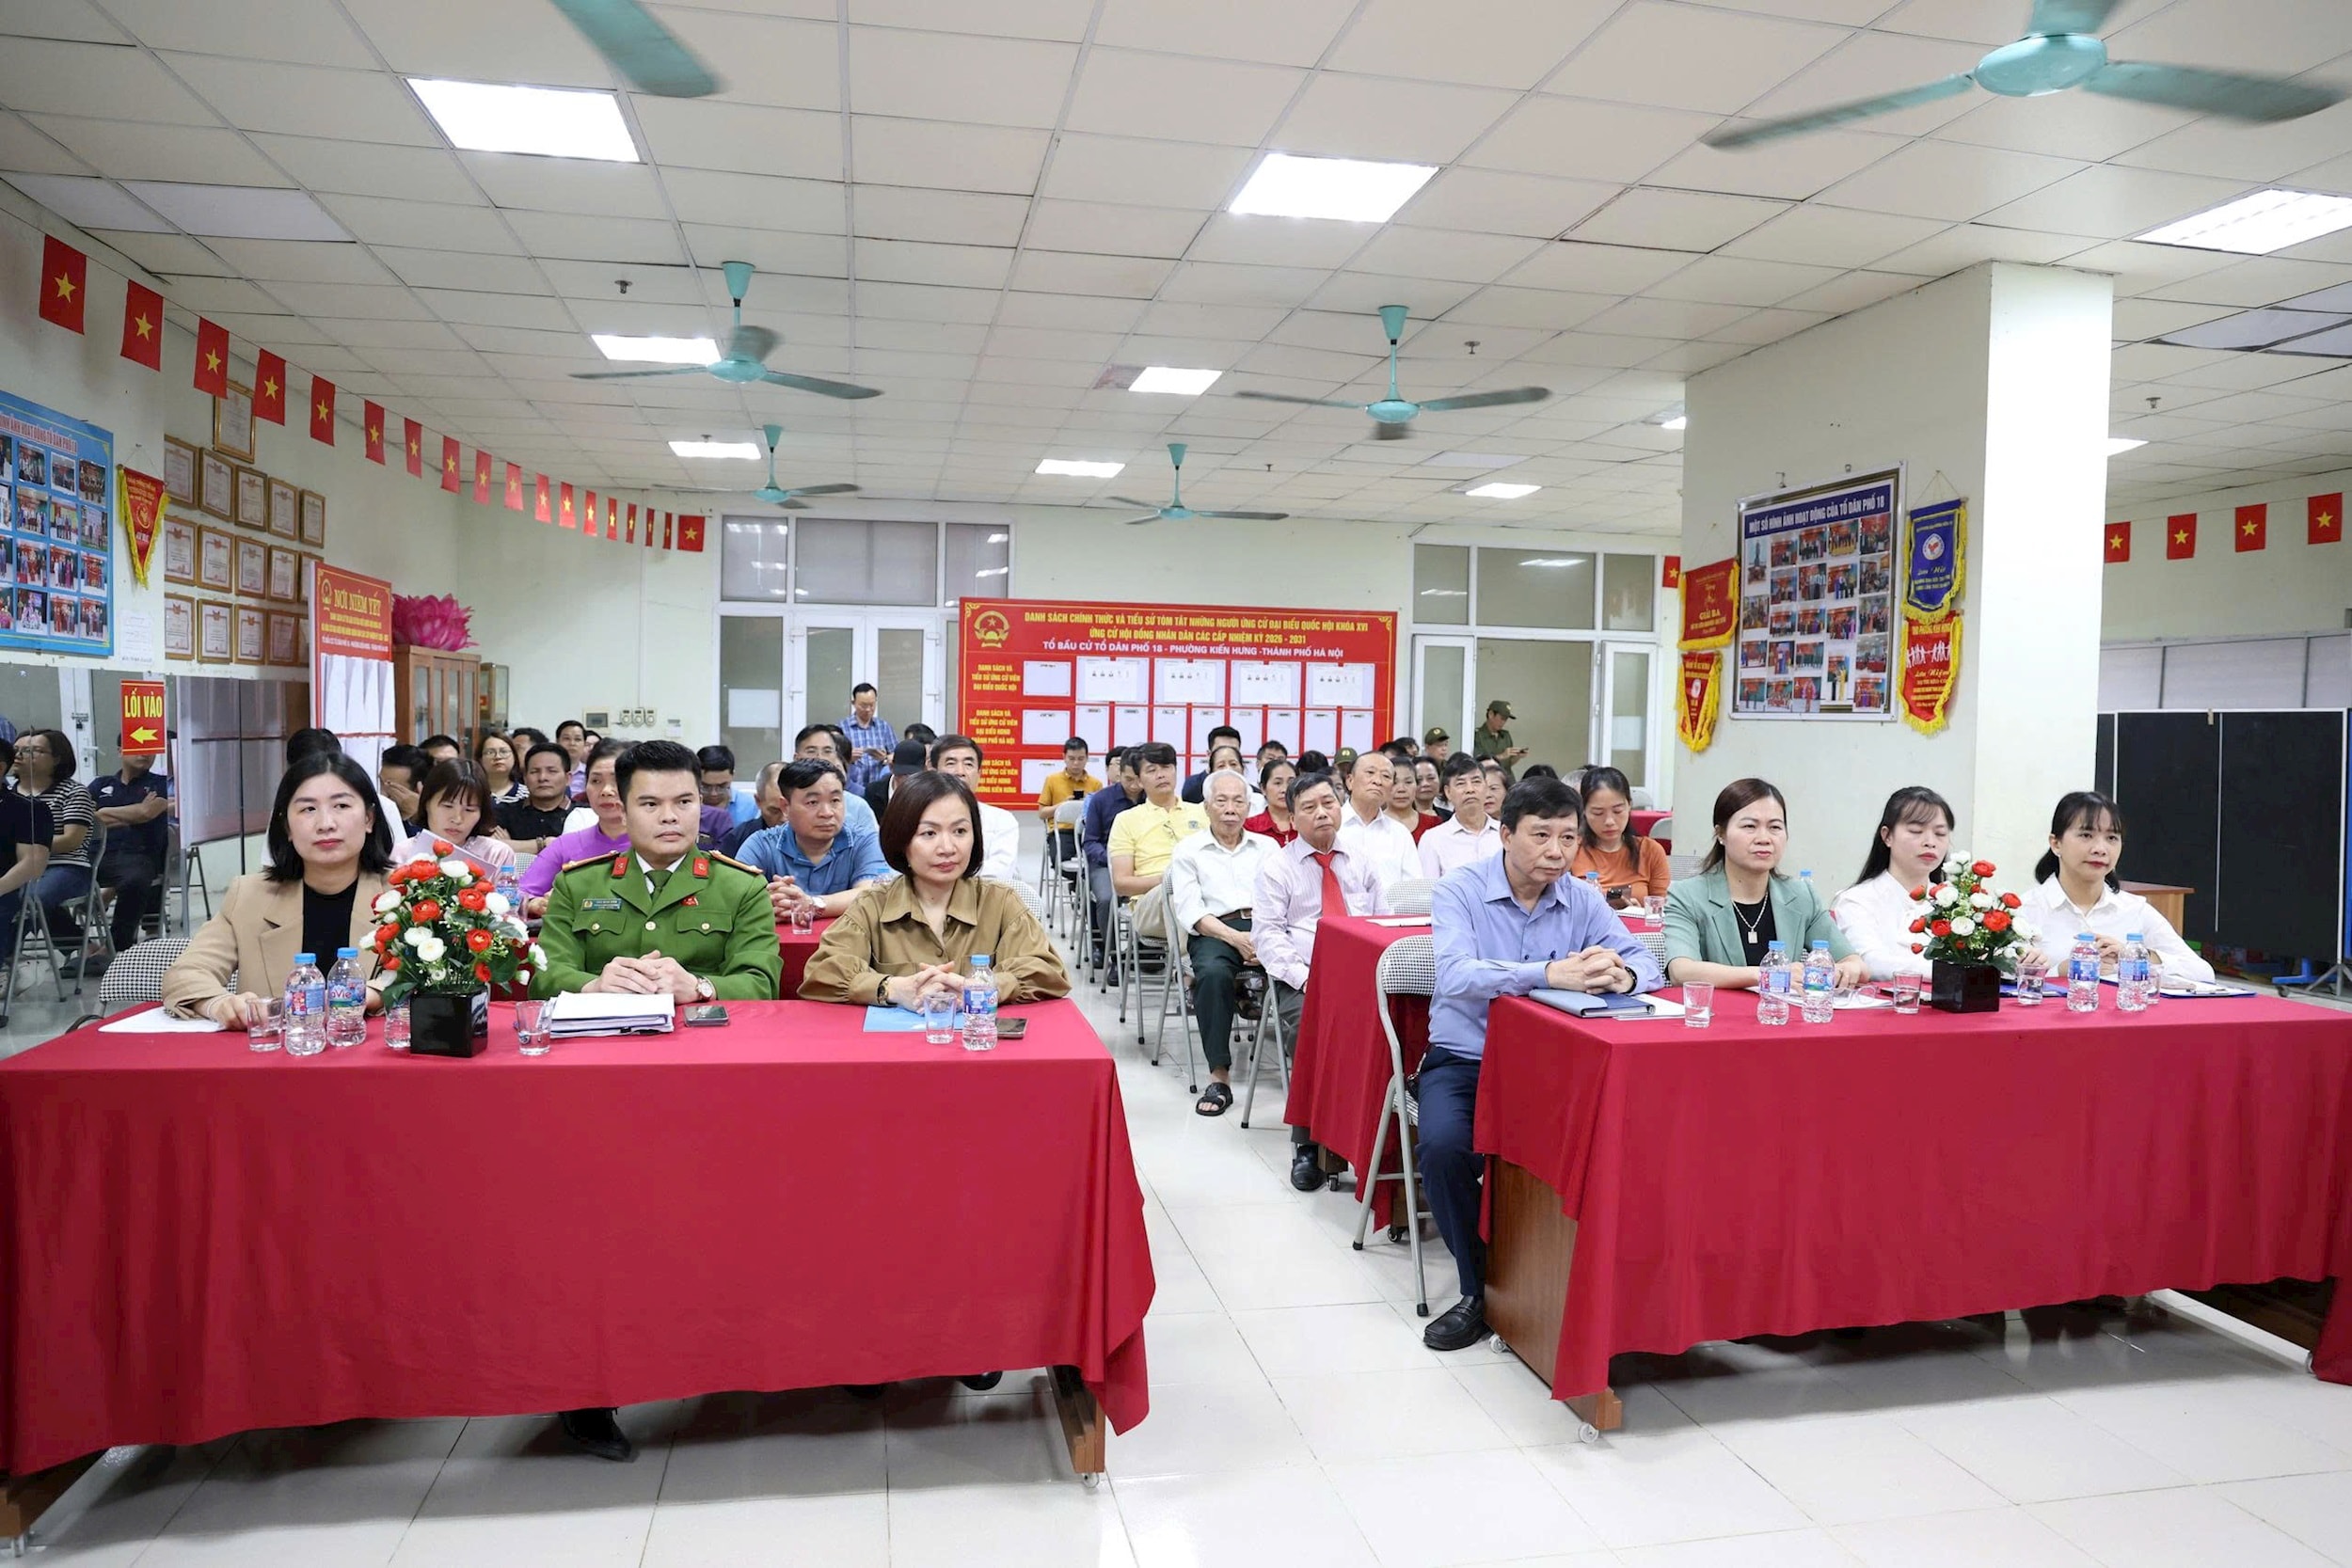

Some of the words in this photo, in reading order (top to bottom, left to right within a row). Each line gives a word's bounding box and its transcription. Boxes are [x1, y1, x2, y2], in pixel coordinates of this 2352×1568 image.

[1761, 516, 1769, 531] SỐ
[1827, 501, 1838, 517] CỦA
[1839, 498, 1849, 515] TỔ
[1849, 499, 1862, 514] DÂN
[1863, 493, 1875, 510] PHỐ
[1877, 496, 1884, 508] 18
[1025, 612, 1045, 623] DANH
[1048, 612, 1068, 624] SÁCH
[1070, 612, 1092, 624] CHÍNH
[1094, 613, 1114, 625] THỨC
[1116, 613, 1125, 624] VÀ
[1127, 613, 1142, 625] TIỂU
[1301, 618, 1320, 630] QUỐC
[1322, 620, 1334, 631] HỘI
[1336, 620, 1355, 631] KHÓA
[1357, 622, 1368, 631] XVI
[1089, 627, 1104, 638] ỨNG
[1120, 628, 1132, 641] HỘI
[1134, 628, 1153, 640] ĐỒNG
[1155, 629, 1176, 641] NHÂN
[1178, 629, 1193, 641] DÂN
[1195, 630, 1211, 641] CÁC
[1212, 630, 1226, 642] CẤP
[1229, 631, 1252, 643] NHIỆM
[1265, 634, 1282, 643] 2026
[1290, 635, 1306, 643] 2031
[1043, 637, 1055, 649] TỔ
[1079, 639, 1092, 650] CỬ
[1095, 638, 1106, 650] TỔ
[1109, 641, 1128, 651] DÂN
[1131, 641, 1151, 652] PHỐ
[1152, 642, 1162, 652] 18
[1169, 642, 1207, 654] PHƯỜNG
[1210, 643, 1230, 655] KIẾN
[1232, 645, 1257, 656] HƯNG
[1294, 645, 1311, 657] PHỐ
[1313, 646, 1326, 657] HÀ
[1327, 646, 1343, 658] NỘI
[124, 688, 141, 718] LỐI
[143, 690, 163, 718] VÀO
